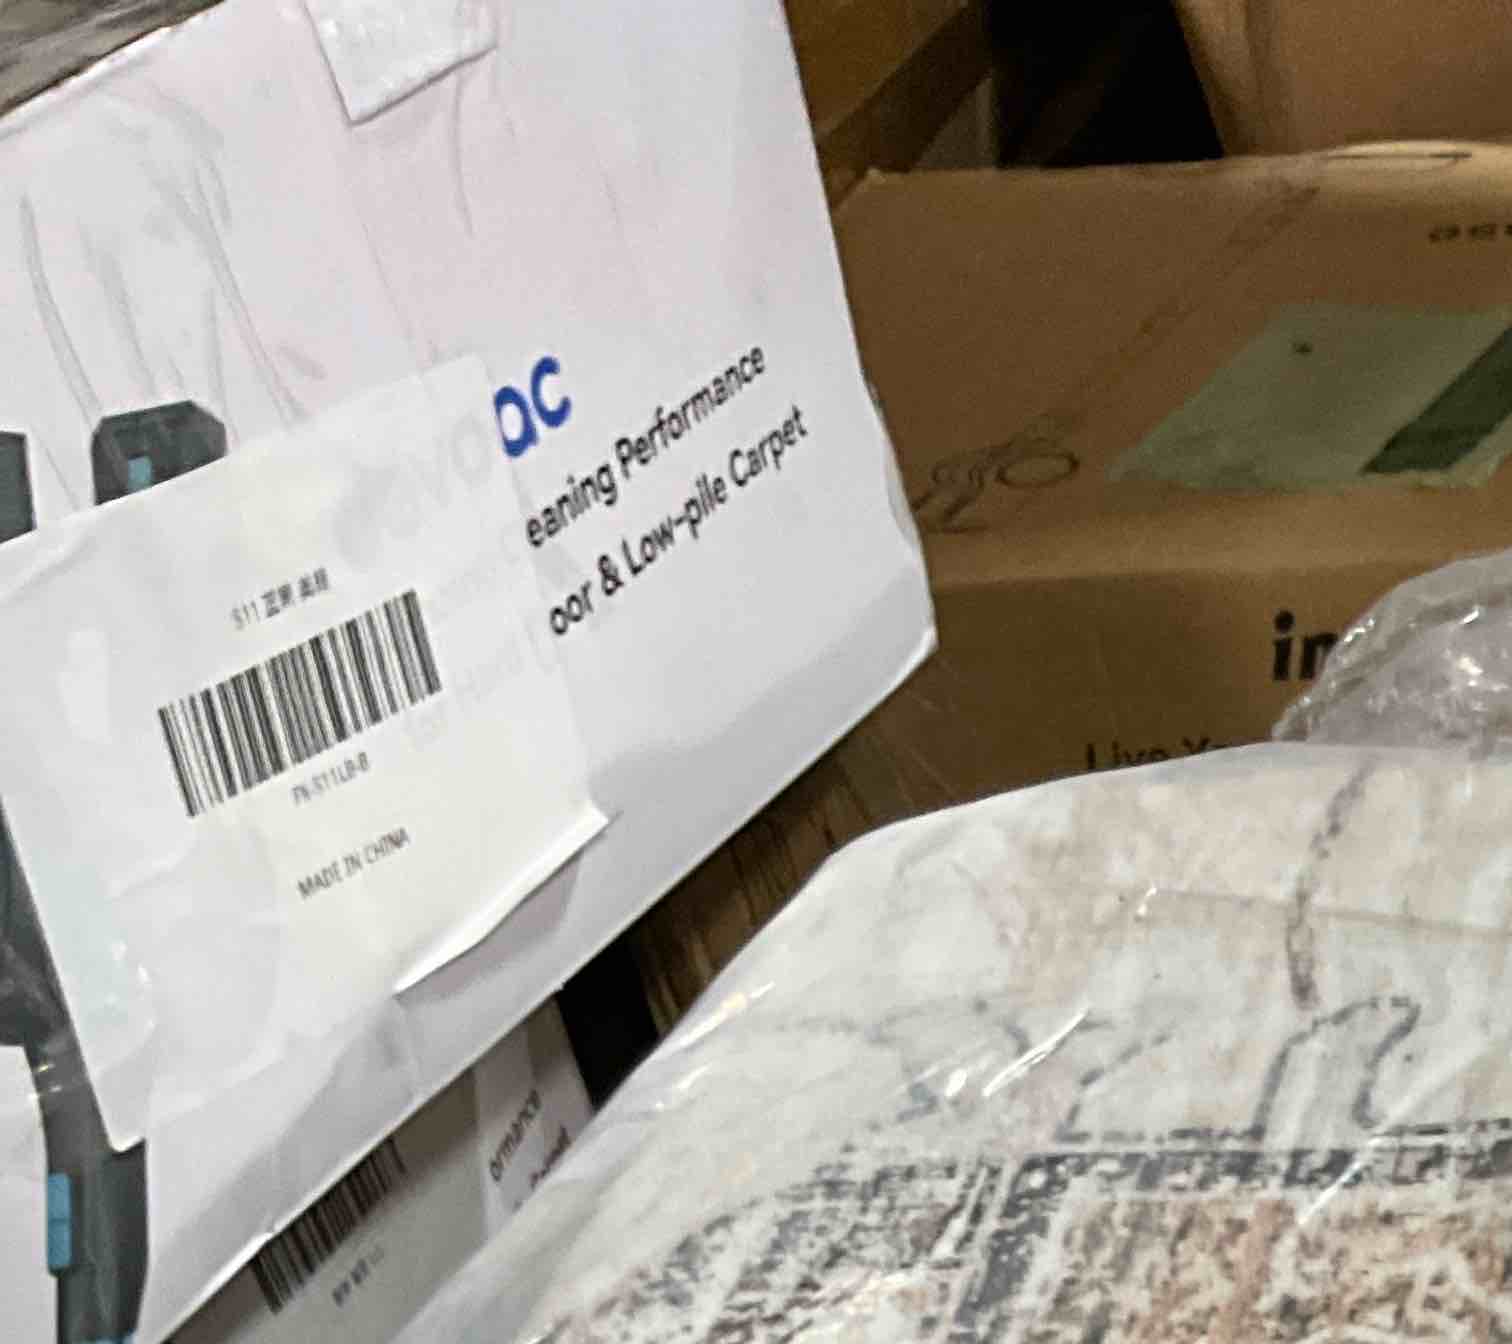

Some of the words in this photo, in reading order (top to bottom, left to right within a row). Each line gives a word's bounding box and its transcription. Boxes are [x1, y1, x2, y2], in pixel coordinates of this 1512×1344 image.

[614, 345, 767, 481] Performance
[597, 553, 625, 598] &
[620, 471, 729, 577] Low-pile
[728, 403, 809, 488] Carpet
[297, 860, 344, 900] MADE
[342, 850, 364, 878] IN
[362, 826, 412, 865] CHINA
